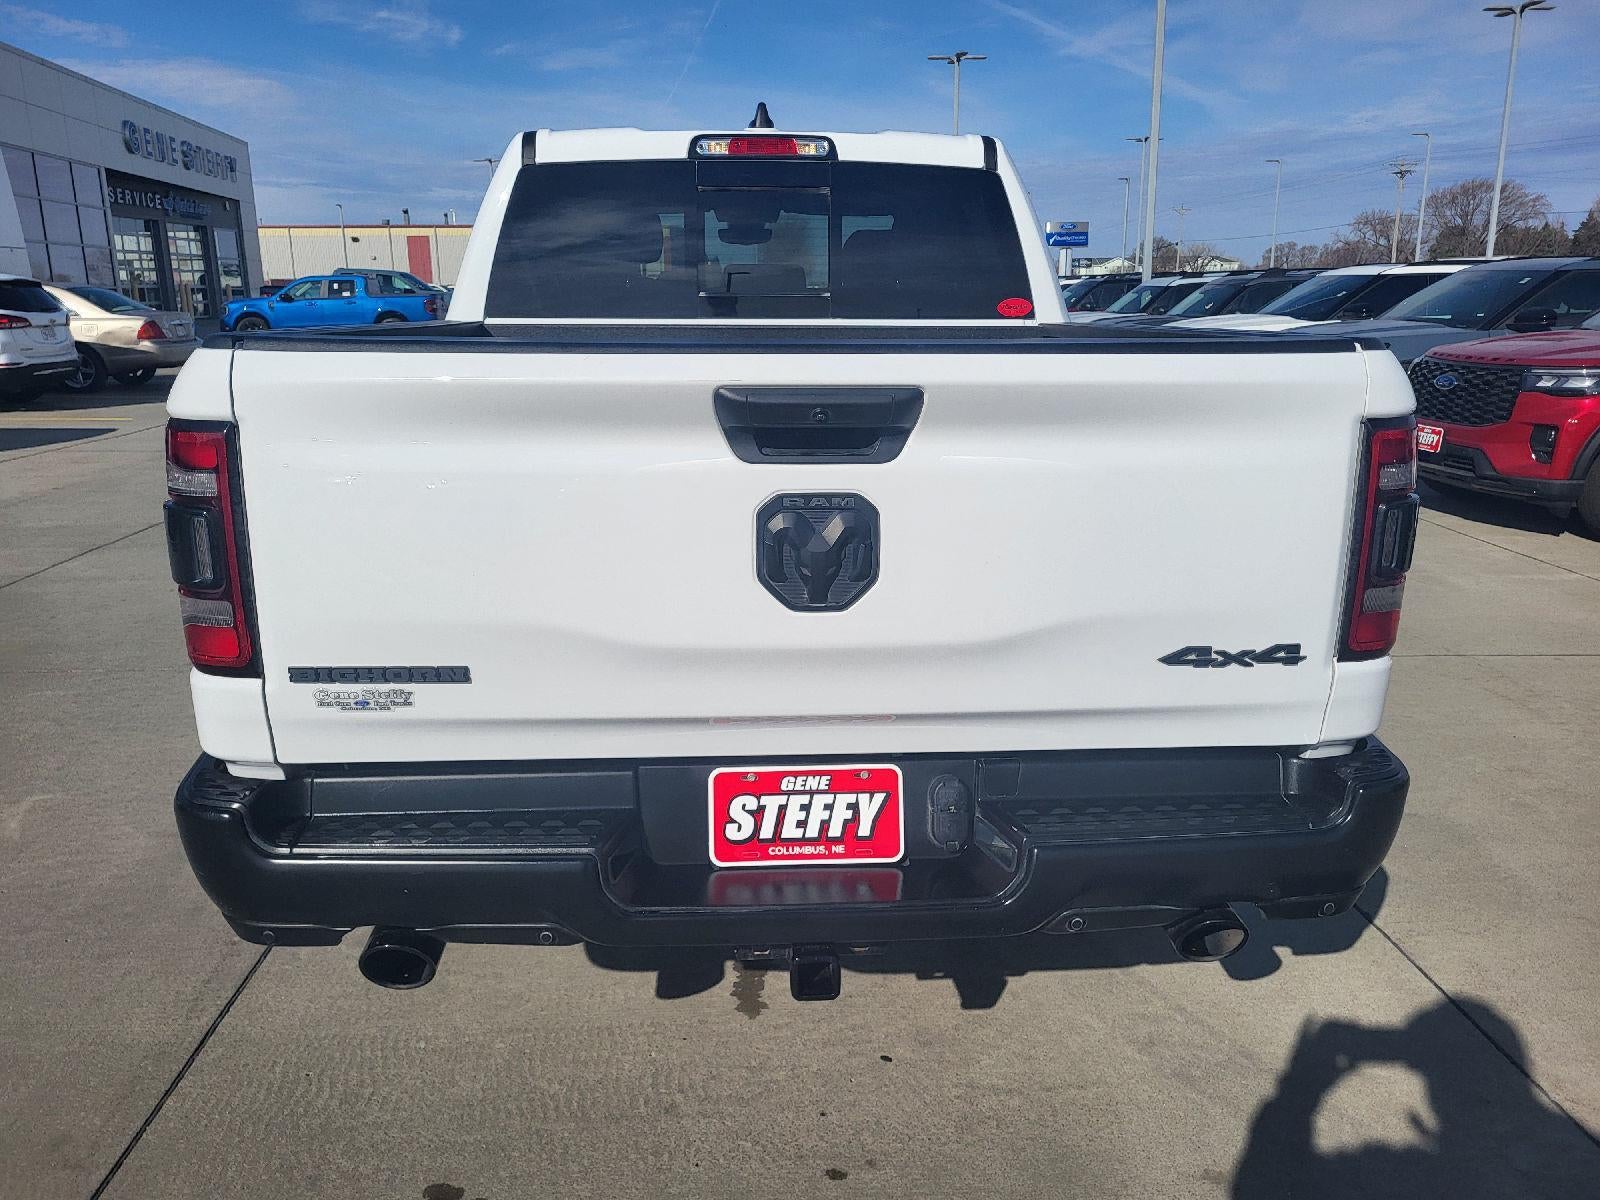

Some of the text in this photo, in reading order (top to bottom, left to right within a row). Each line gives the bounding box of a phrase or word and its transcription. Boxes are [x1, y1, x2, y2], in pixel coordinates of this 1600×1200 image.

[122, 120, 238, 183] GENE STEFFY
[107, 186, 162, 209] SERVICE
[782, 497, 855, 507] RAM
[1157, 643, 1307, 668] 4x4
[288, 666, 471, 683] BIGHORN
[313, 688, 414, 701] Gene Steffy
[780, 775, 831, 791] GENE
[723, 791, 890, 843] STEFFY
[768, 845, 845, 856] COLUMBUS, NE
